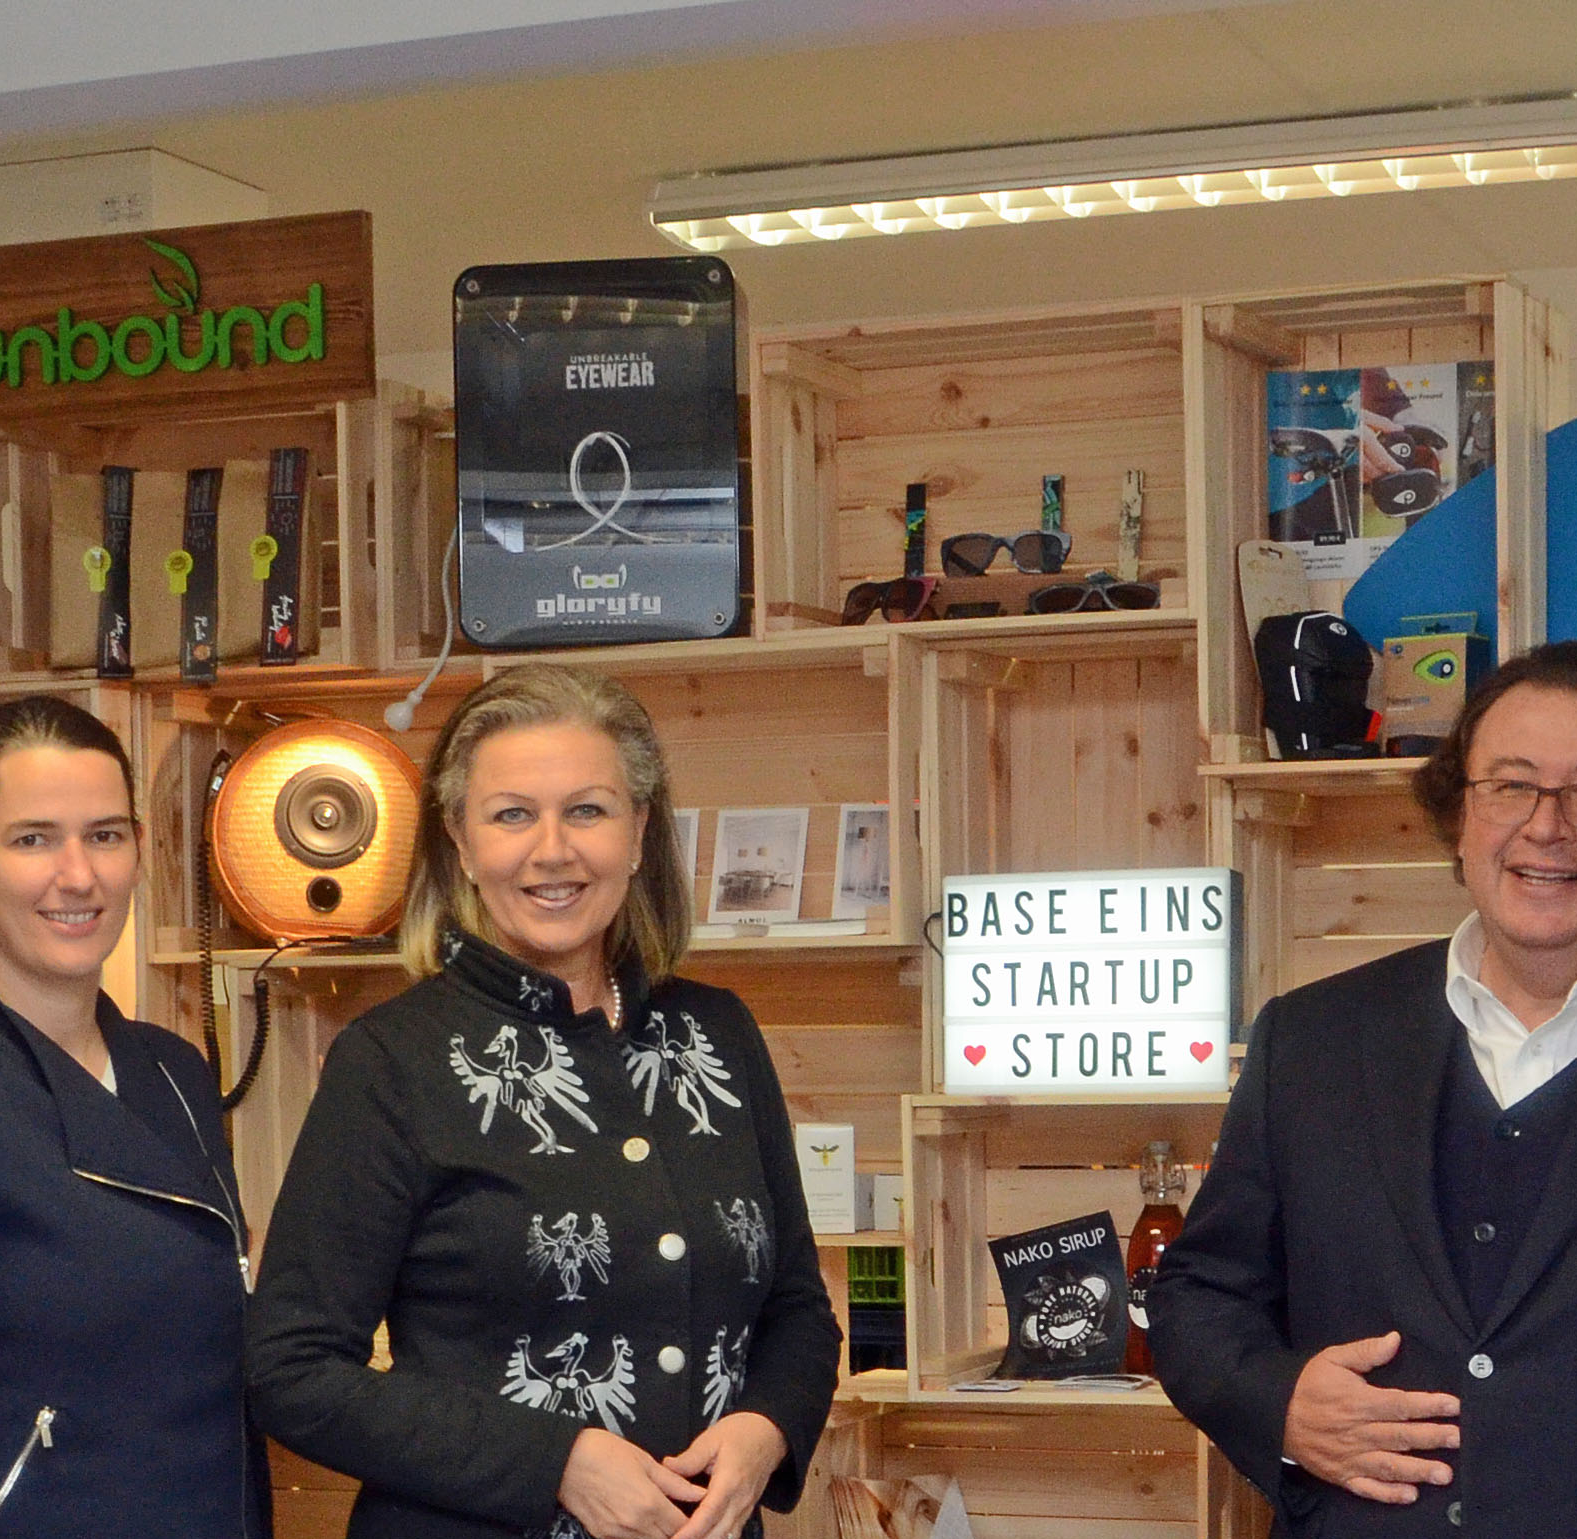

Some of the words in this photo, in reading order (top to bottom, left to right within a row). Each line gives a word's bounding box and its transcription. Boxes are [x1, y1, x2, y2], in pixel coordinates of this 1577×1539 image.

[565, 361, 655, 389] EYEWEAR
[536, 593, 661, 618] gloryfy
[947, 885, 1067, 938] BASE
[1099, 884, 1223, 934] EINS
[972, 958, 1193, 1007] STARTUP
[1011, 1031, 1167, 1078] STORE
[1003, 1241, 1054, 1268] NAKO
[1058, 1227, 1106, 1254] SIRUP
[1054, 1309, 1083, 1325] nako
